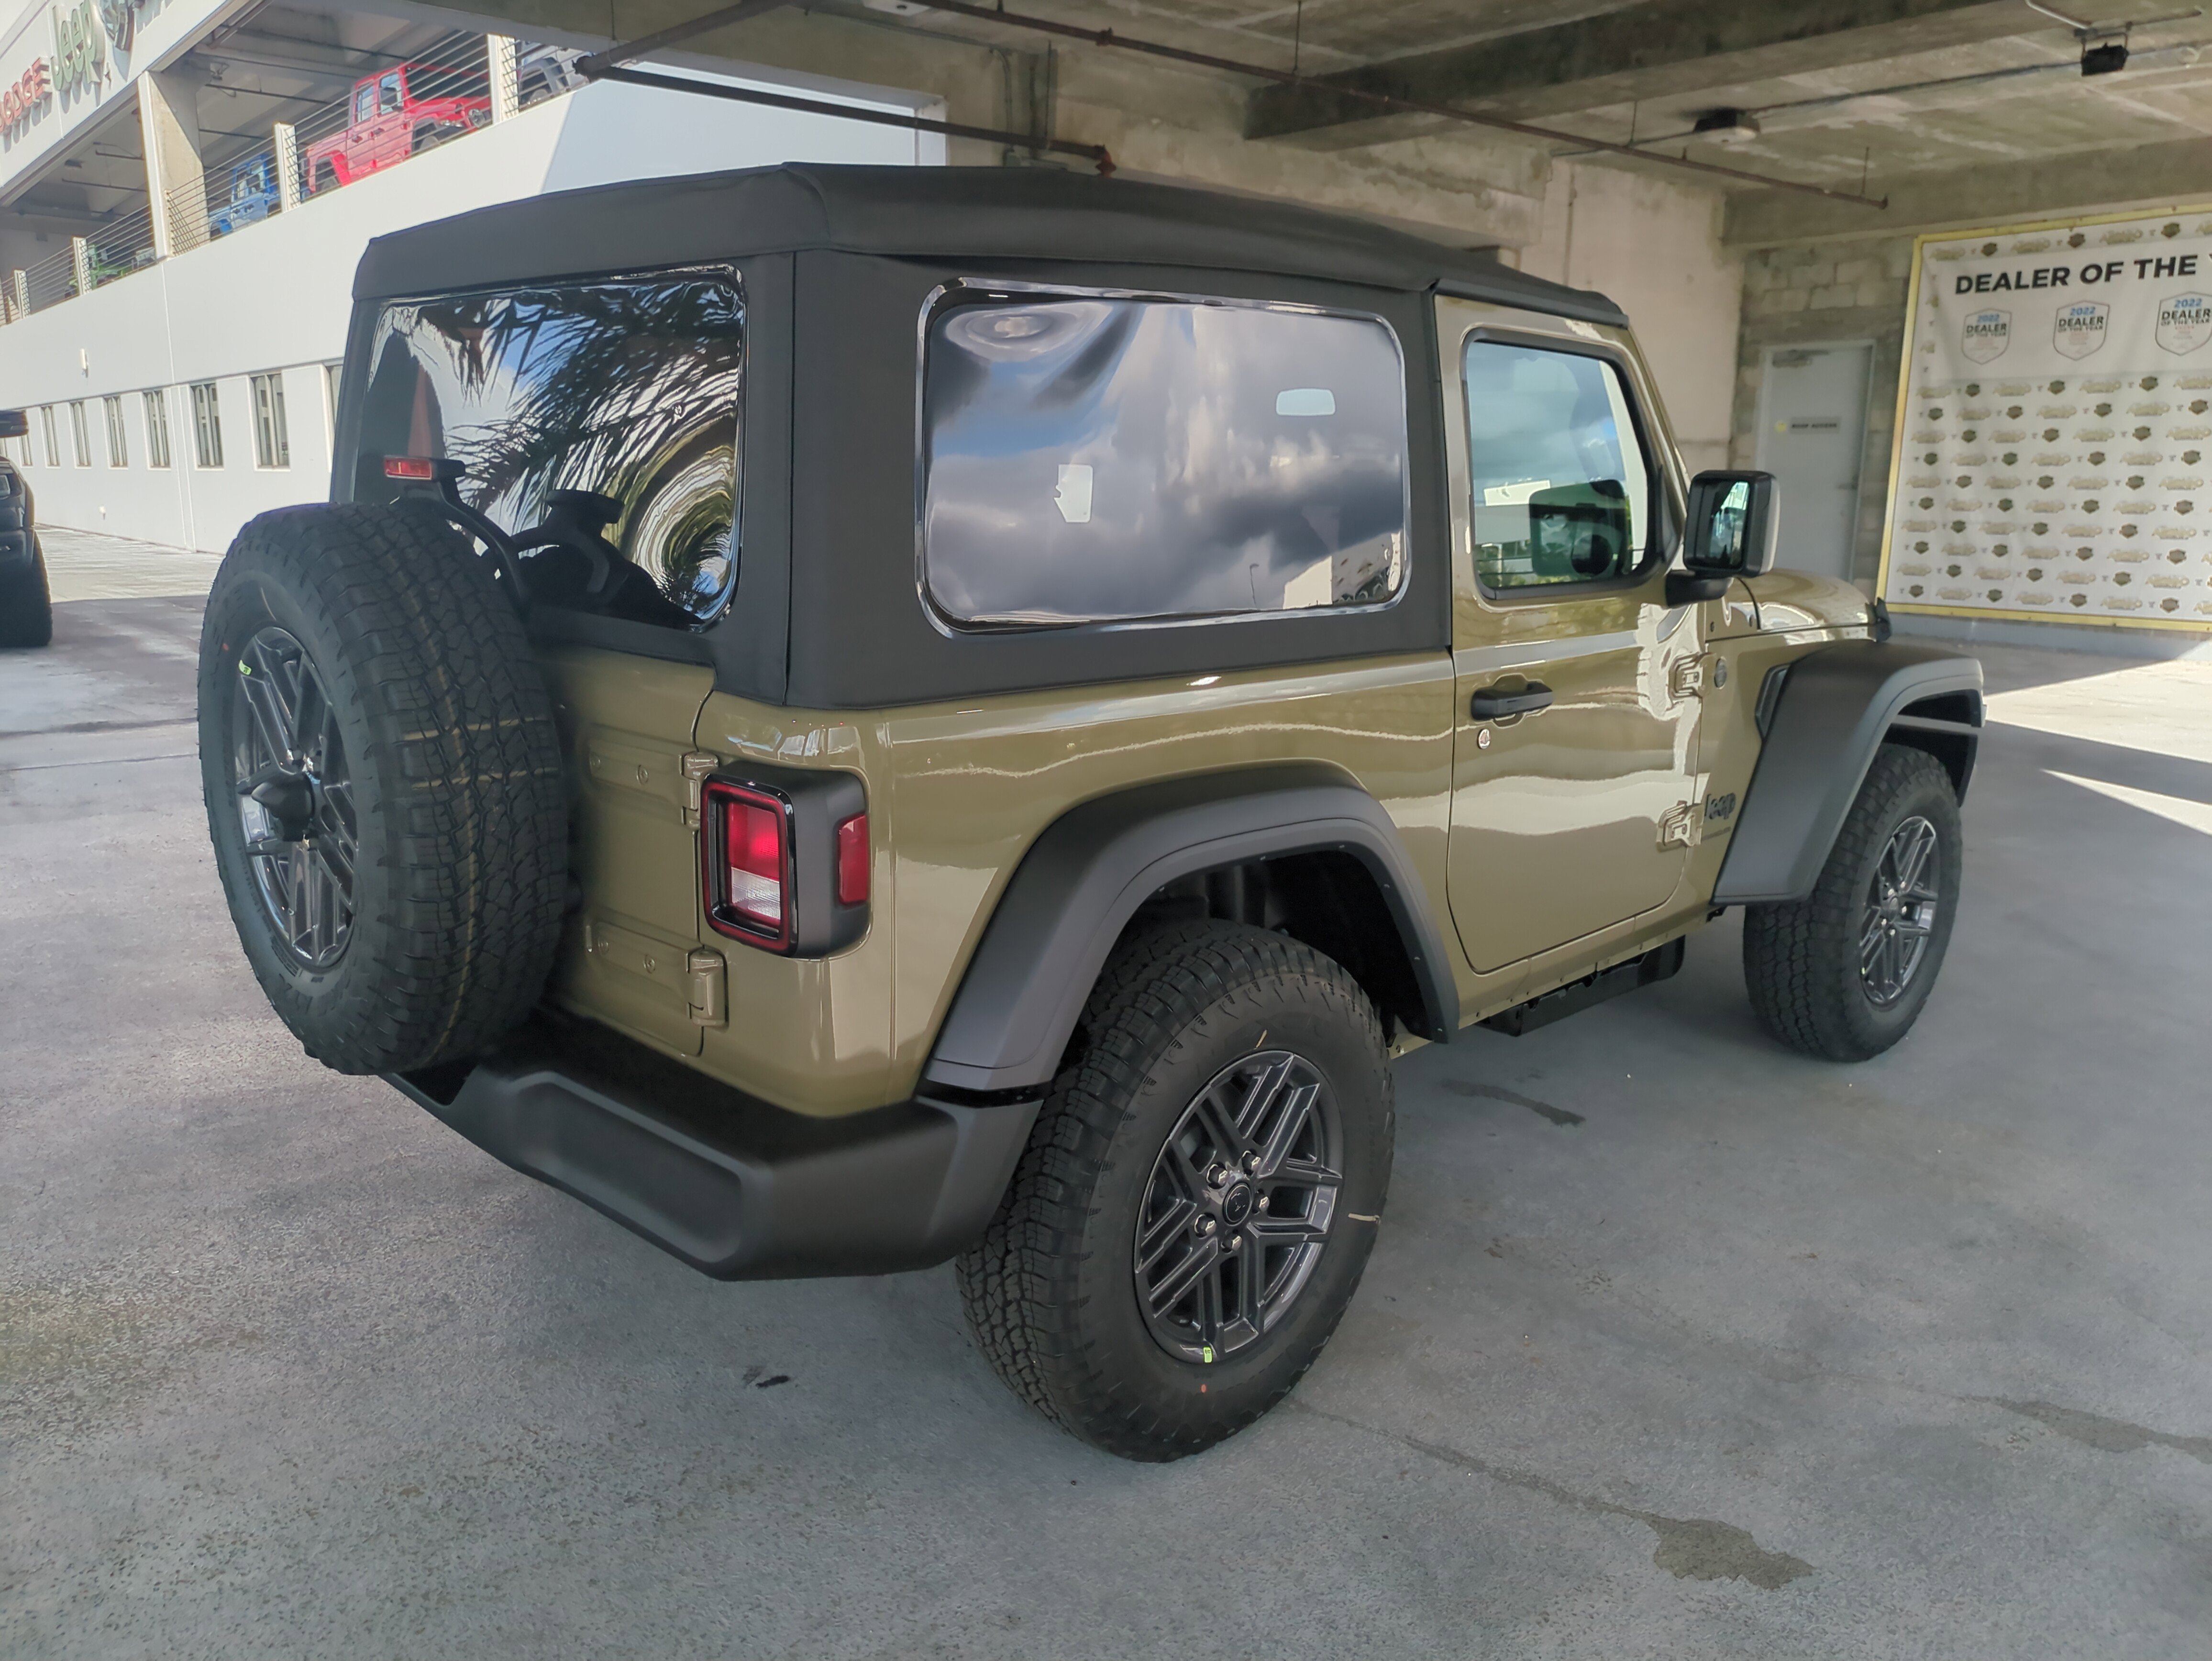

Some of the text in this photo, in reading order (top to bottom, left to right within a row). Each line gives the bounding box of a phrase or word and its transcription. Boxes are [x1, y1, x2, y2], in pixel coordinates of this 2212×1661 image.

[50, 0, 100, 91] Jeep
[1955, 255, 2198, 295] DEALER OF THE
[2174, 298, 2202, 309] 2022
[2162, 308, 2211, 320] DEALER
[2058, 316, 2104, 327] DEALER
[1966, 323, 2007, 334] DEALER
